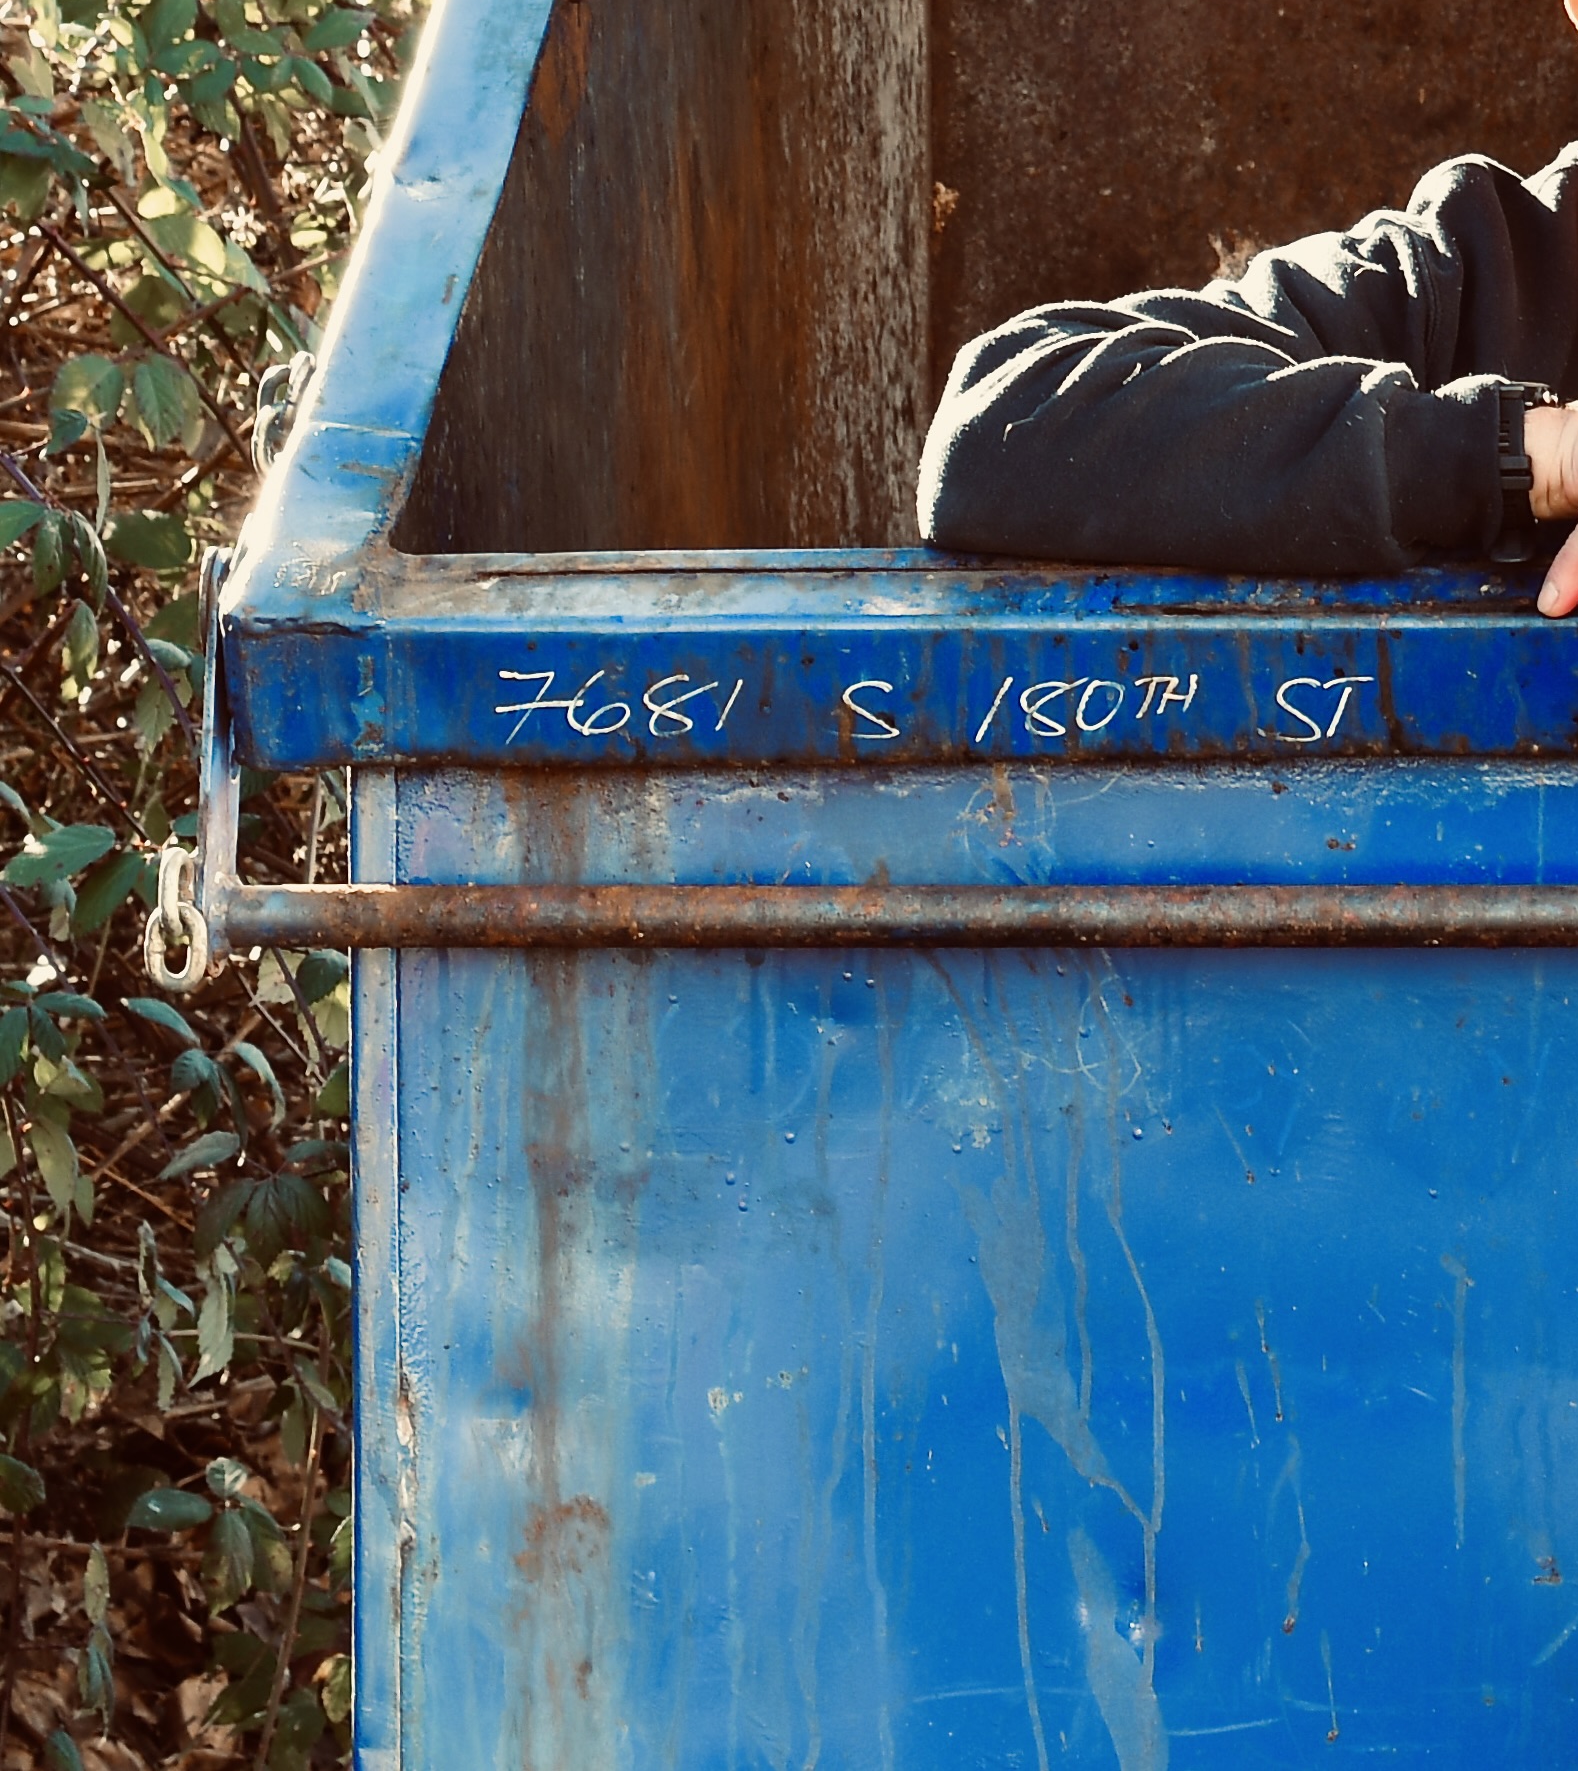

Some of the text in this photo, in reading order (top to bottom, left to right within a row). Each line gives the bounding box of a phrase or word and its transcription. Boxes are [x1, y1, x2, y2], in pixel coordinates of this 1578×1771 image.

[496, 670, 1374, 744] 7681 S 180TH ST
